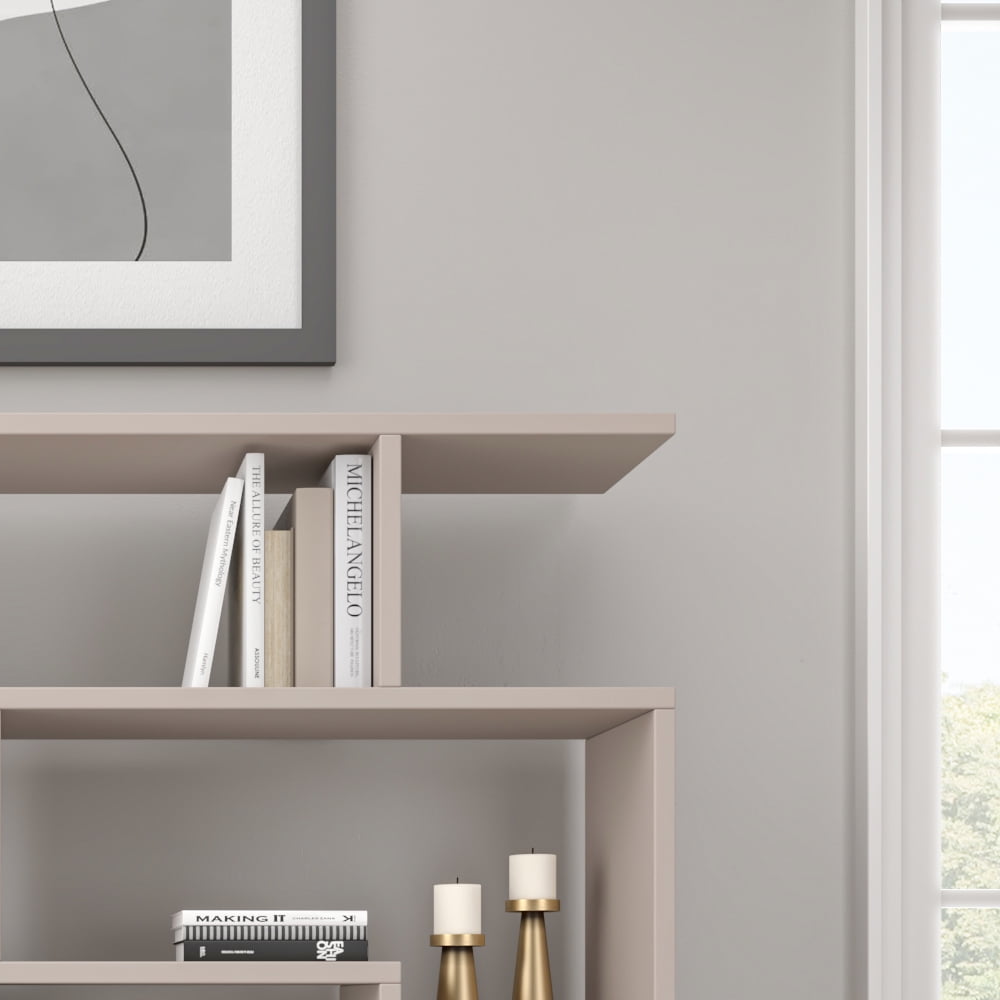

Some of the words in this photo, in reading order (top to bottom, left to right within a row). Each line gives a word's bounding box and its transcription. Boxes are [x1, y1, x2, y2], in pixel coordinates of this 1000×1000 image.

[251, 466, 261, 488] THE
[228, 501, 237, 518] Near
[251, 490, 261, 537] ALLURE
[223, 519, 234, 547] Eastern
[251, 539, 261, 554] OF
[346, 464, 363, 617] MICHELANGELO
[214, 548, 229, 587] Mythology
[251, 557, 261, 605] BEAUTY
[196, 915, 269, 923] MAKING
[273, 914, 286, 923] IT
